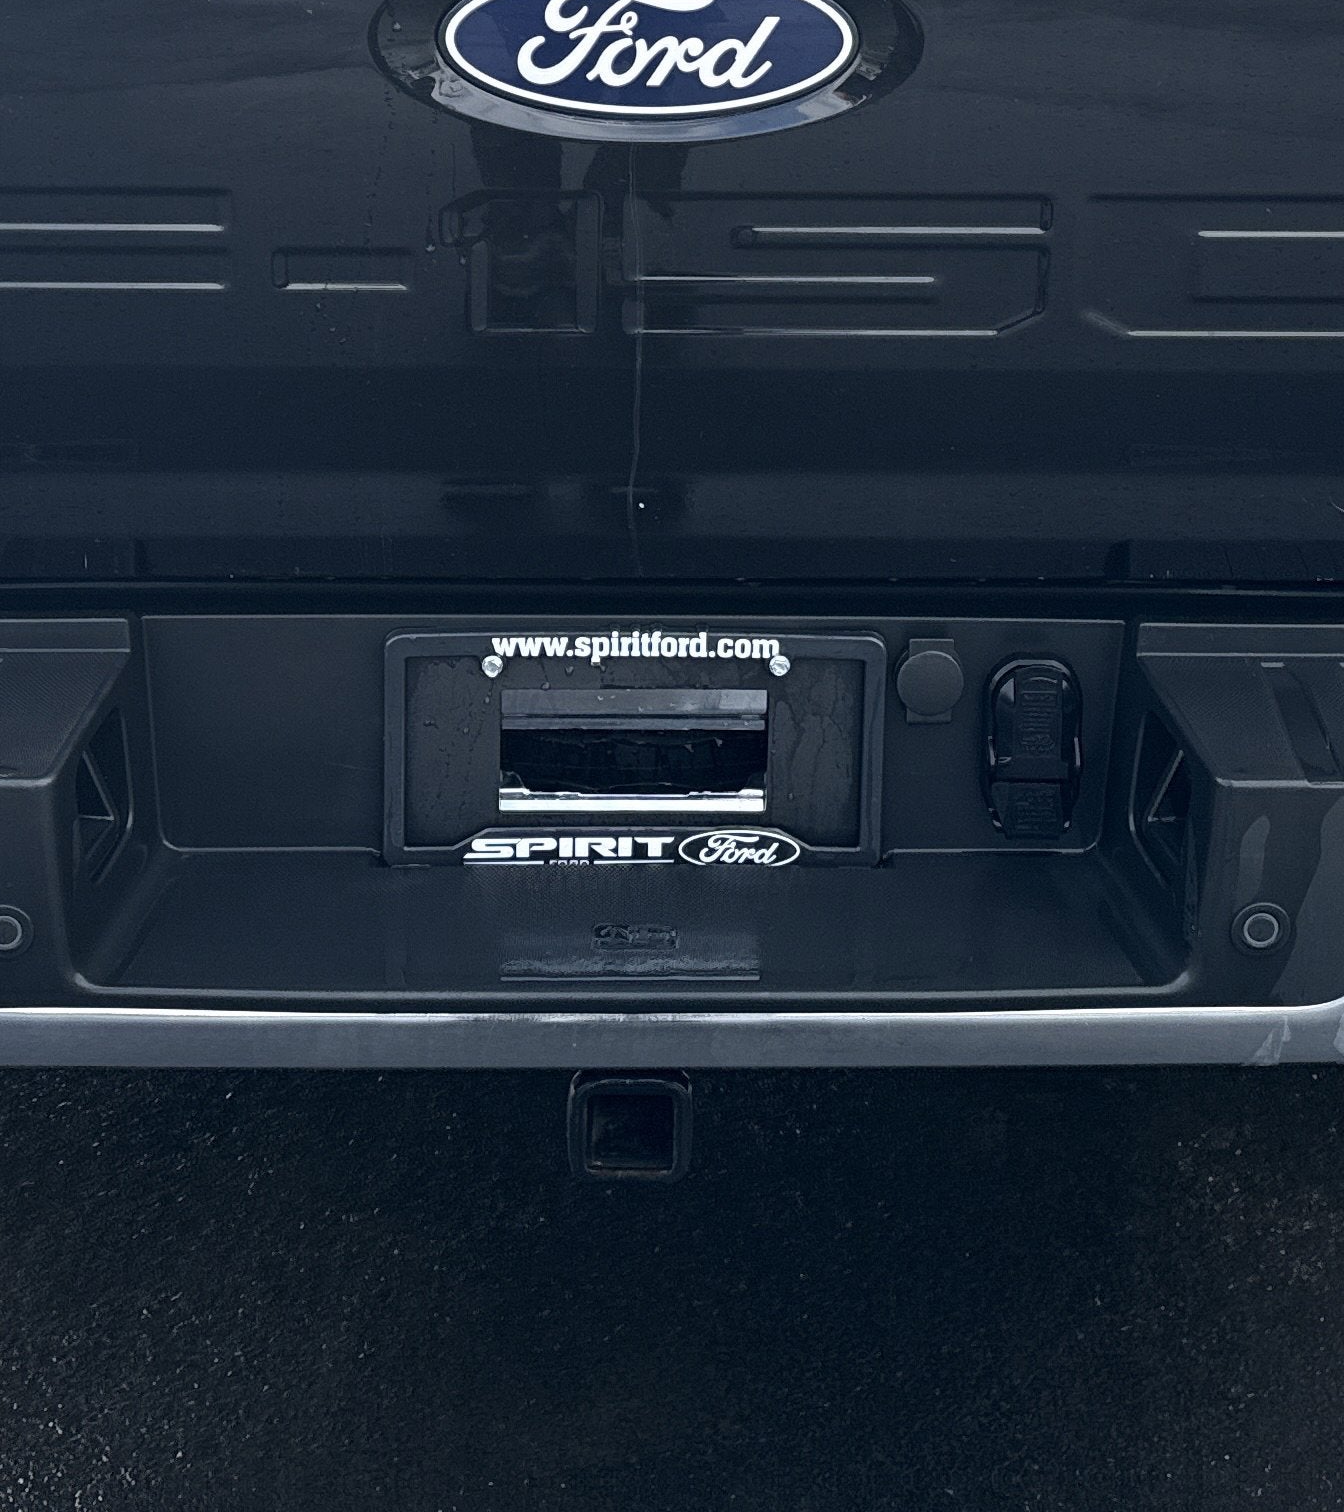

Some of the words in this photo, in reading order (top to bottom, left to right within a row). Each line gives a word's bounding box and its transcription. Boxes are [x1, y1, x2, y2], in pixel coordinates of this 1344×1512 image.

[492, 631, 780, 666] www.spiritford.com
[463, 835, 675, 859] SPIRIT
[698, 834, 780, 865] Ford
